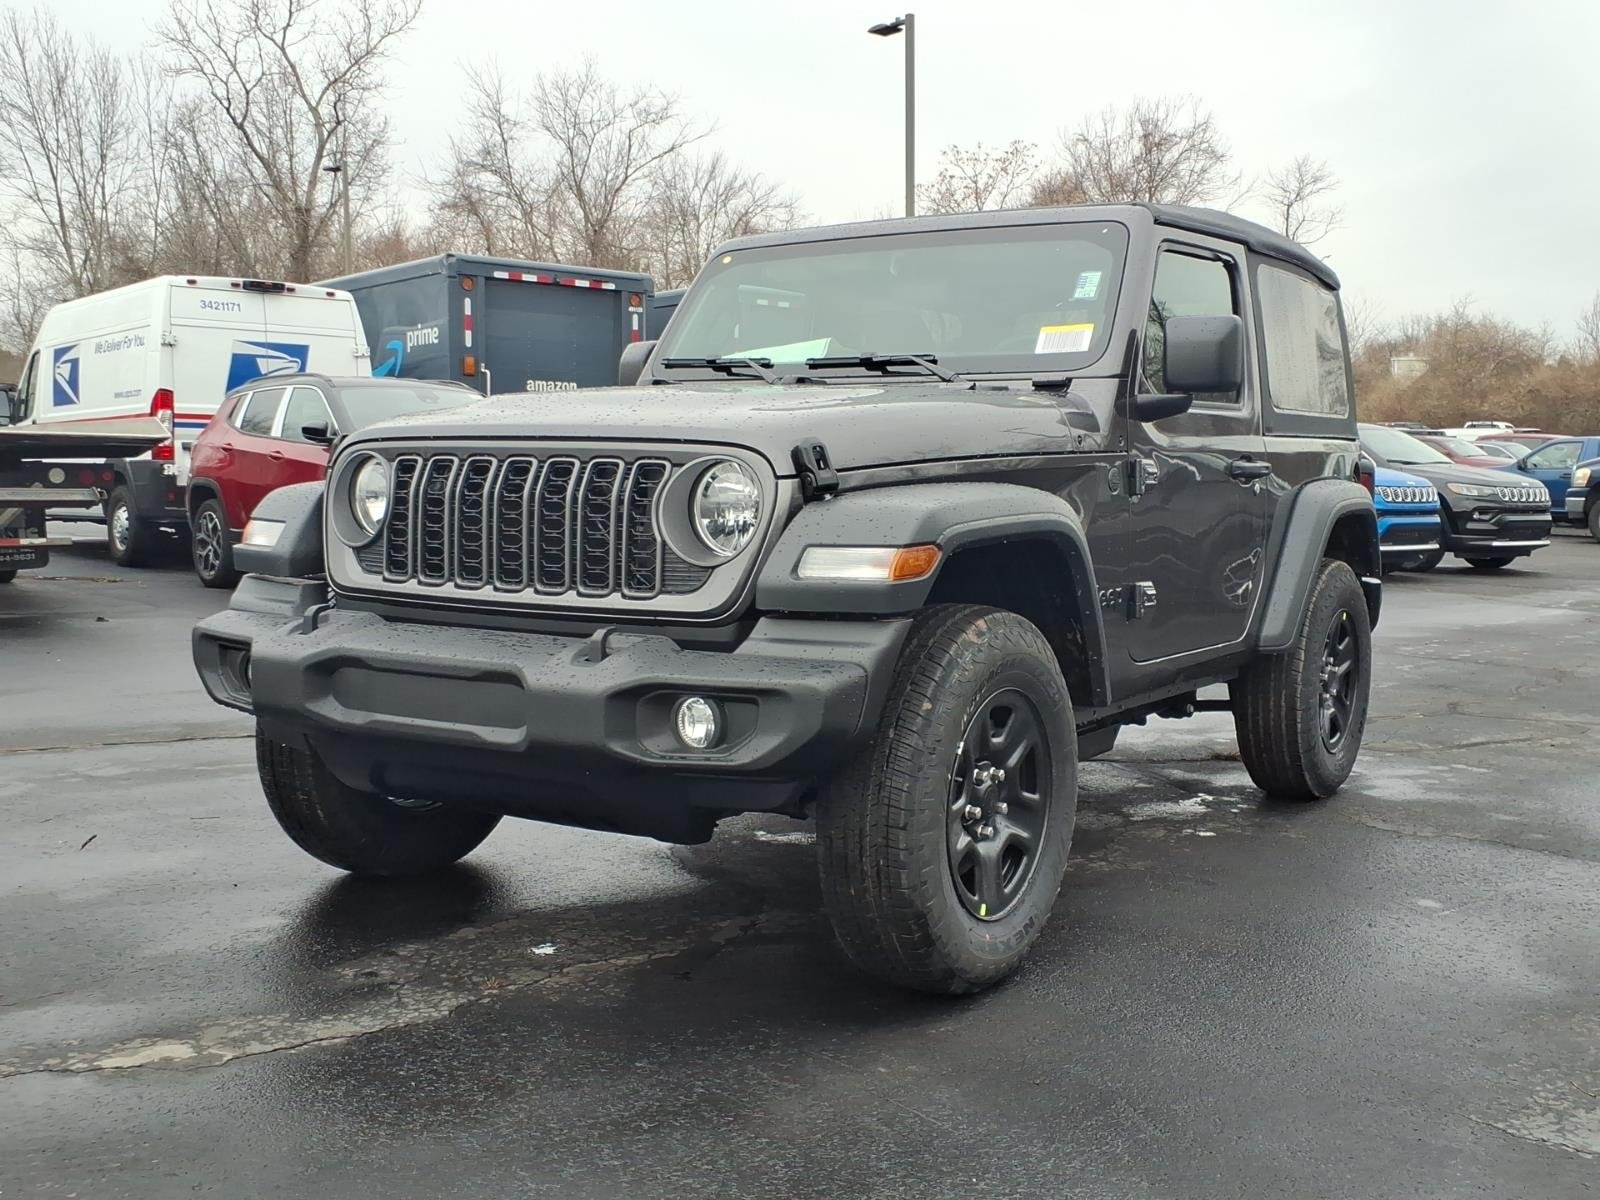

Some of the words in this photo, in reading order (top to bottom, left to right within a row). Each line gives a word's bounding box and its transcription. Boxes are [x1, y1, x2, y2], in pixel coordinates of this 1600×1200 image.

[200, 299, 241, 312] 3421171
[94, 341, 103, 355] We
[103, 339, 123, 354] Deliver
[123, 335, 134, 350] For
[407, 323, 439, 353] prime
[526, 379, 578, 391] amazon
